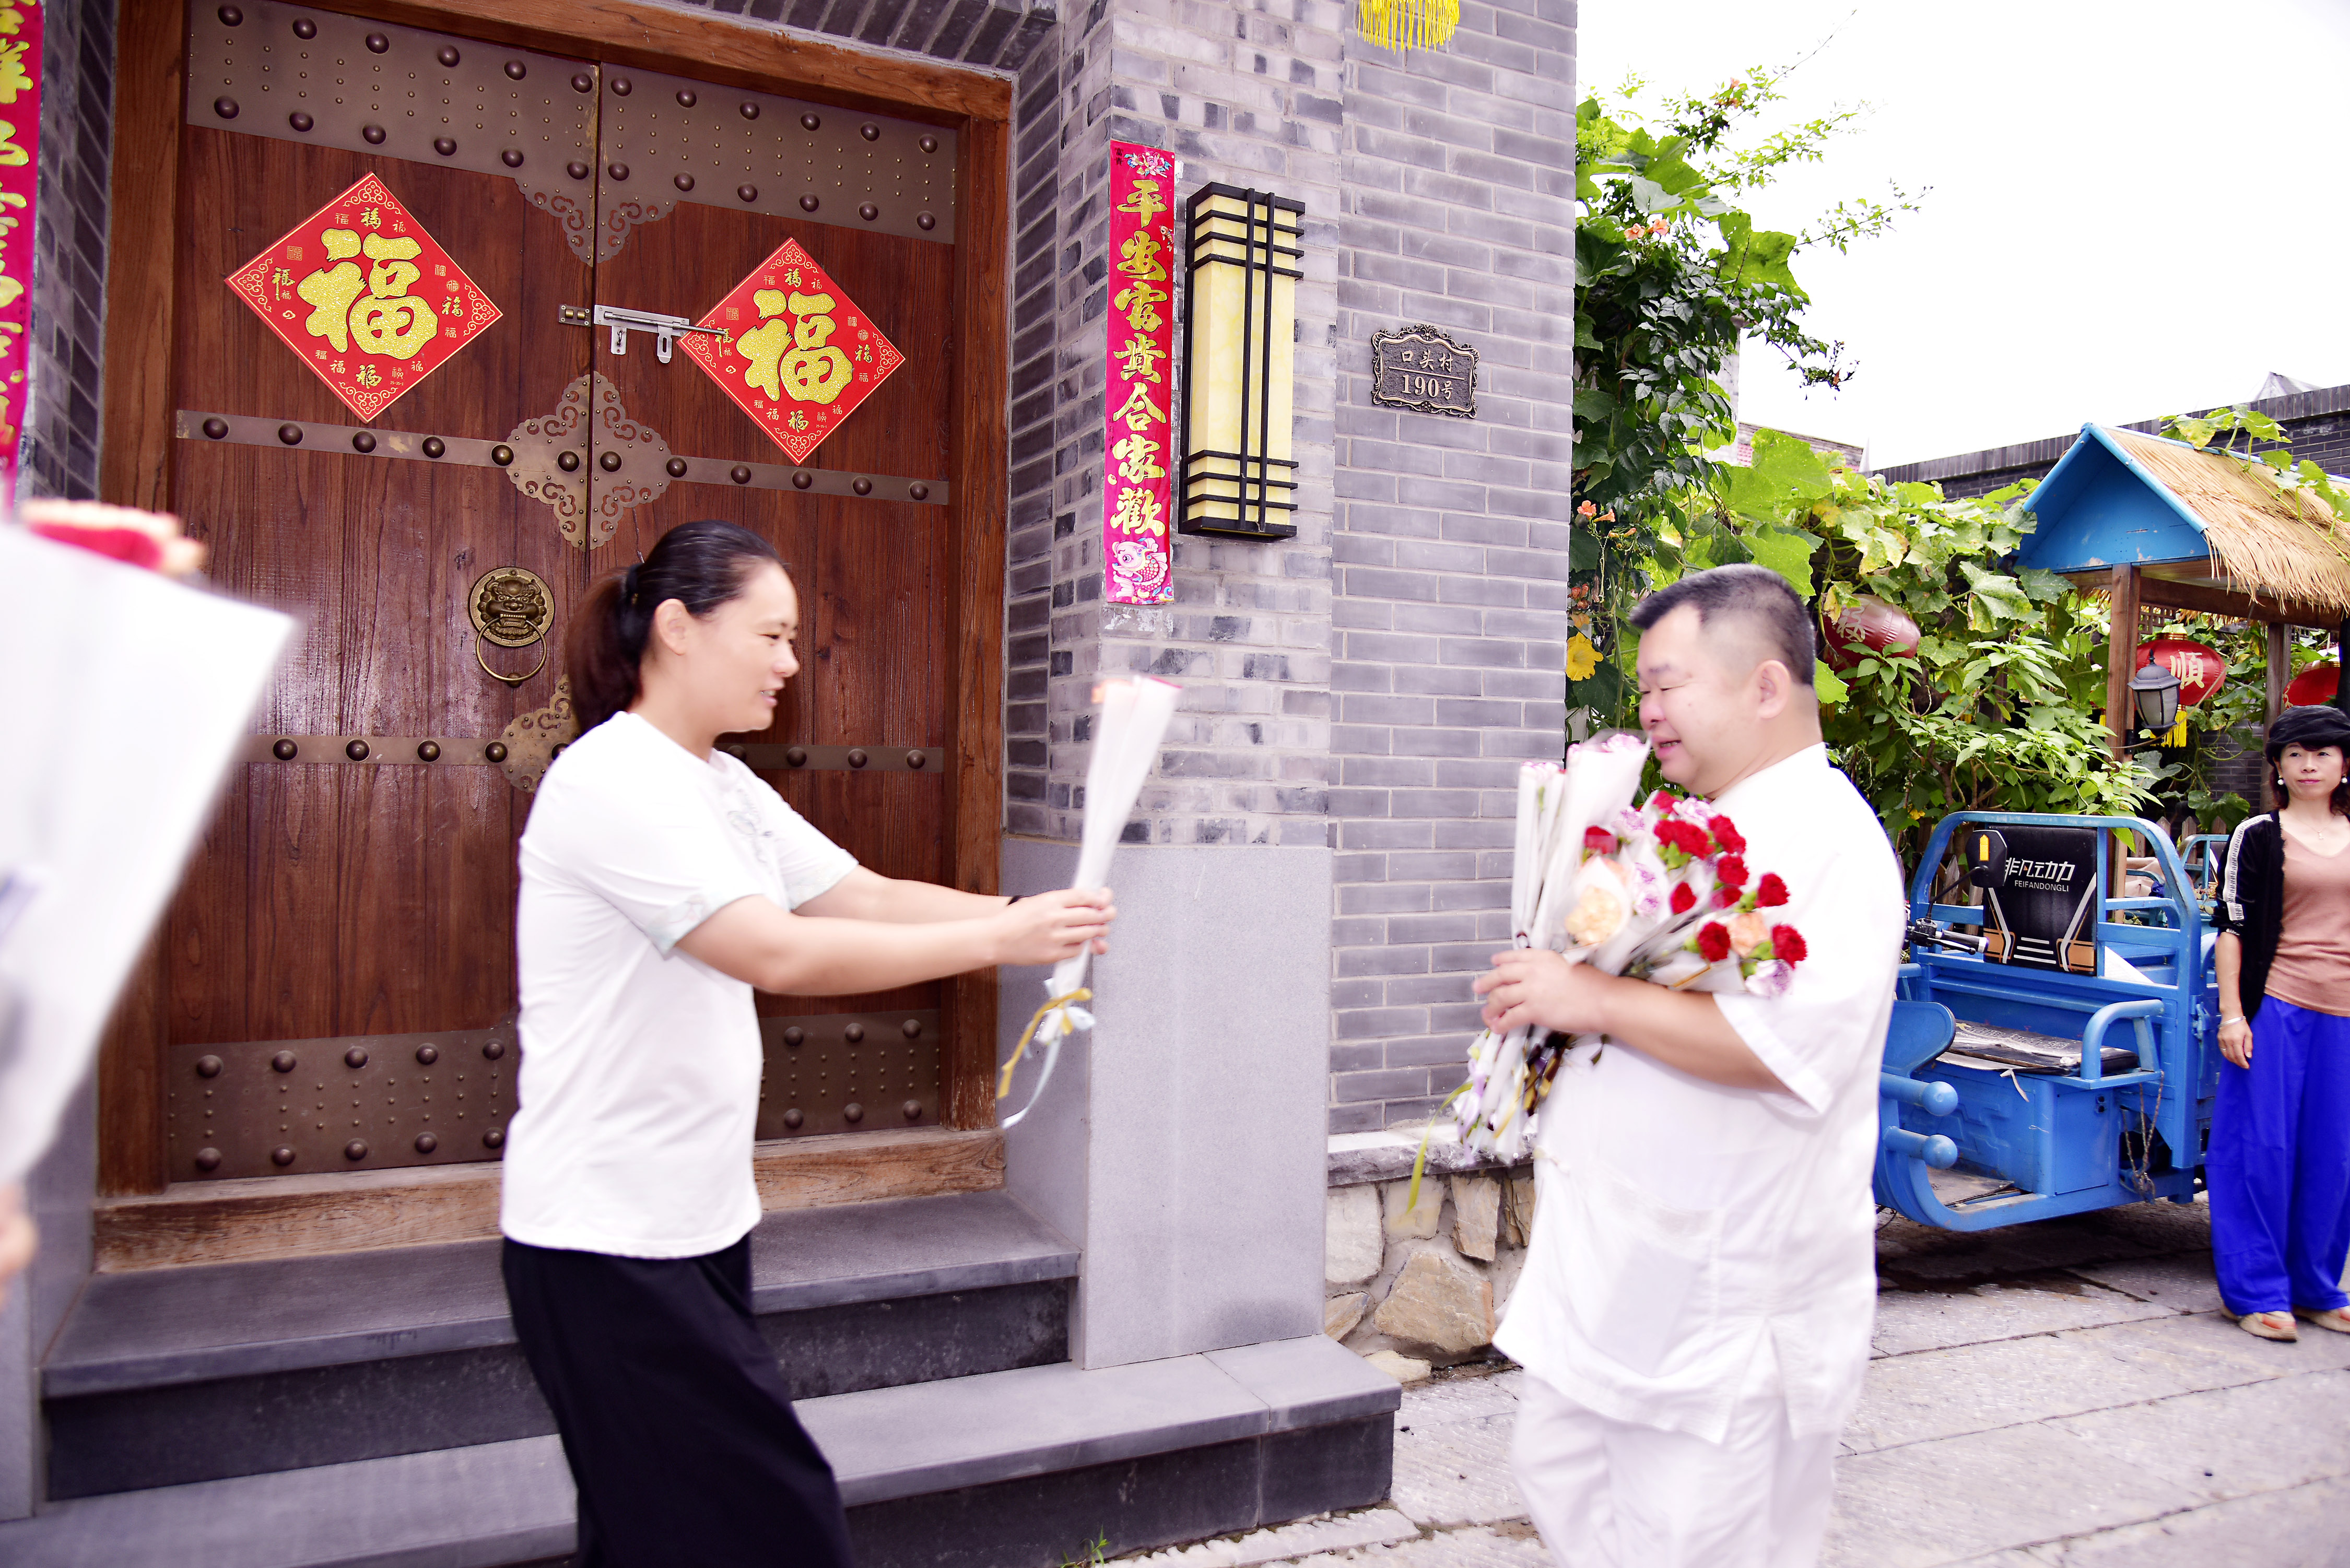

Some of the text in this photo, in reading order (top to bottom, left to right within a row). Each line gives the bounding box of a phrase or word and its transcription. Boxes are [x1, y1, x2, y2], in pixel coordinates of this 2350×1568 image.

[335, 213, 349, 225] 福
[763, 275, 776, 285] 福
[281, 290, 291, 300] 福
[297, 228, 438, 360] 福
[445, 327, 456, 338] 福
[723, 347, 732, 356] 福
[736, 288, 853, 405] 福
[315, 350, 327, 360] 福
[1401, 349, 1453, 373] 口头村
[330, 360, 346, 374] 福
[859, 372, 868, 382] 福
[1402, 374, 1453, 400] 190号
[754, 400, 763, 408] 福
[766, 408, 779, 420] 福
[2170, 651, 2205, 690] 順
[2004, 857, 2075, 882] 非凡动力
[2014, 880, 2069, 892] FEIFANDONGLI
